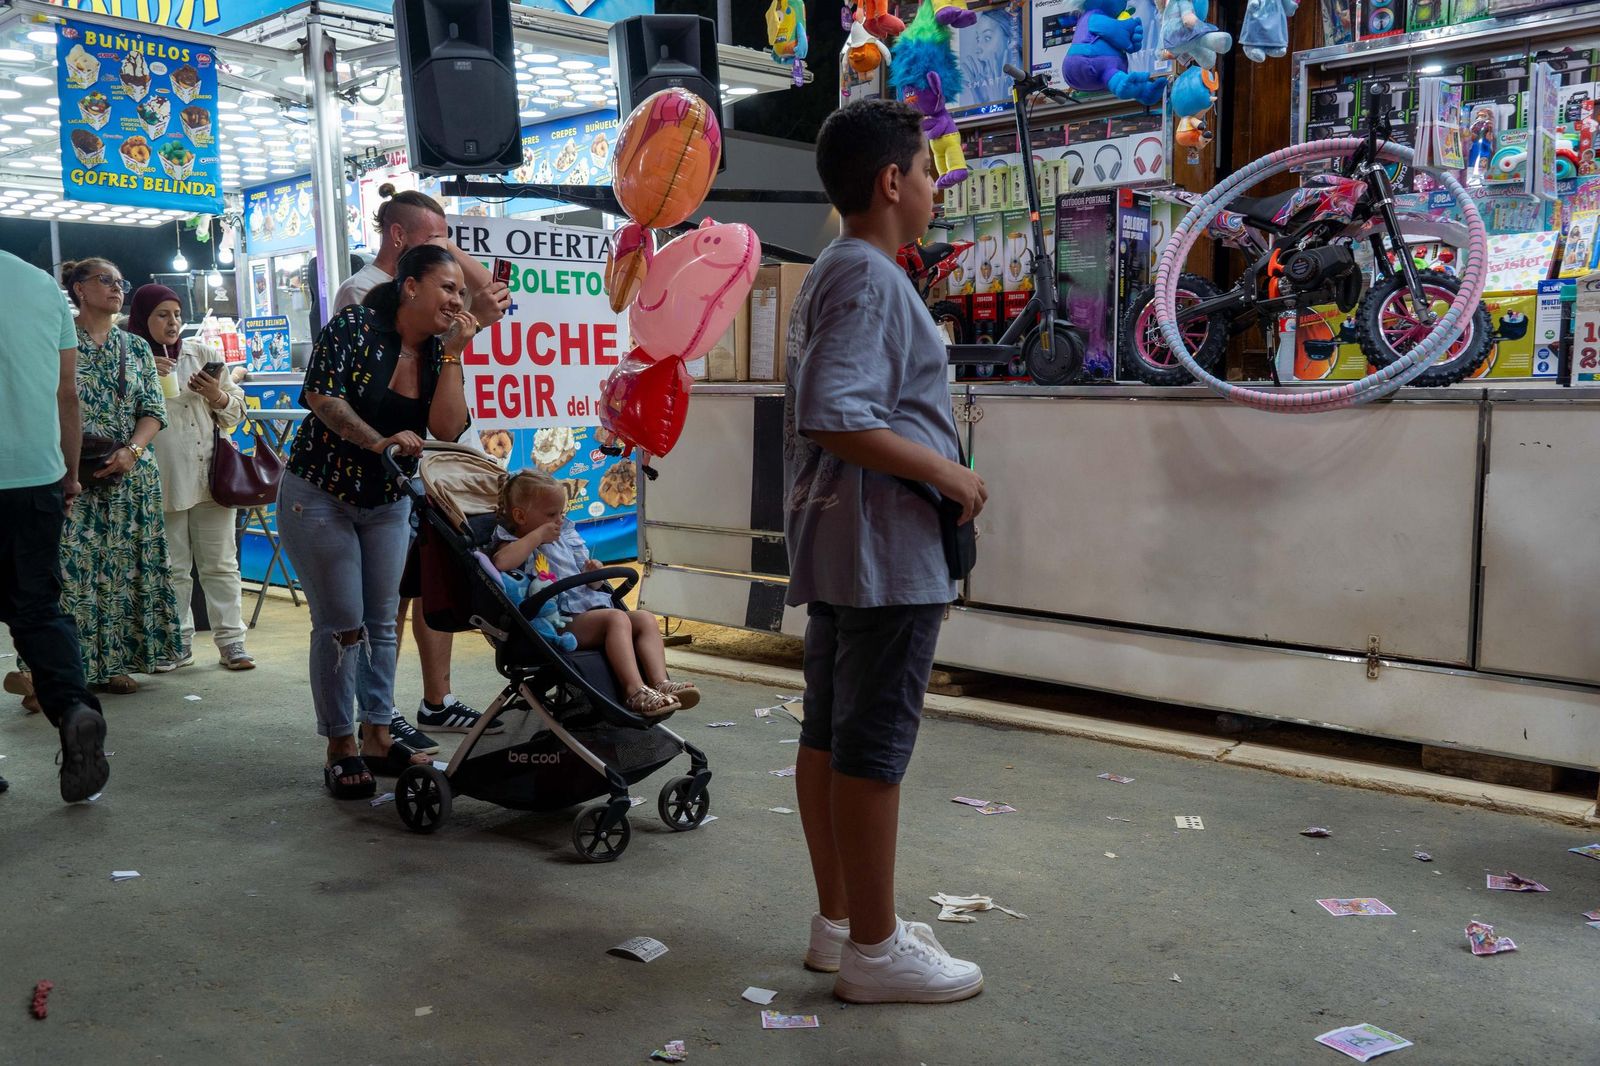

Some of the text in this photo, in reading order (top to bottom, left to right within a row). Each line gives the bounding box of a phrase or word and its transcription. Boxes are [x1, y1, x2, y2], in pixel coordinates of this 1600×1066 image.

[85, 31, 190, 62] BUÑUELOS
[551, 128, 576, 140] CREPES
[70, 168, 216, 196] GOFRES BELINDA
[1061, 194, 1110, 207] OUTDOOR PORTABLE
[506, 230, 611, 260] OFERTA
[508, 263, 611, 296] BOLETO
[1584, 322, 1600, 342] 1
[1580, 347, 1600, 368] 2
[466, 374, 558, 419] EGIR
[567, 396, 590, 416] del
[508, 750, 560, 764] be cool
